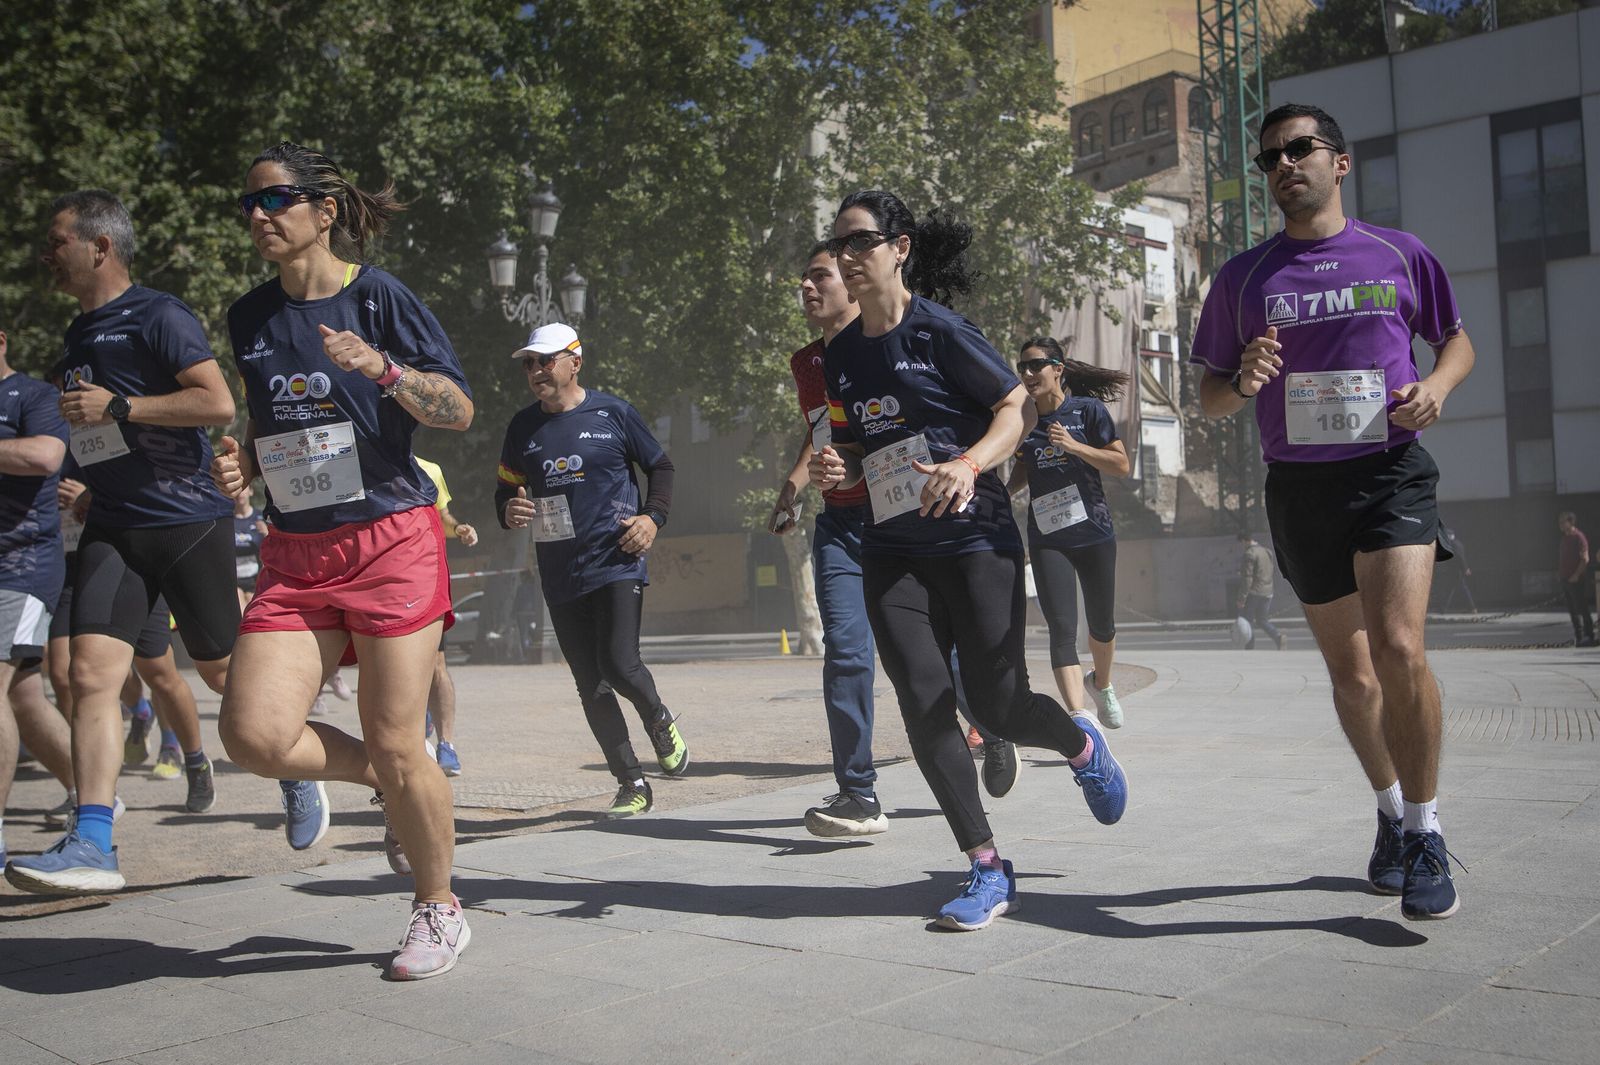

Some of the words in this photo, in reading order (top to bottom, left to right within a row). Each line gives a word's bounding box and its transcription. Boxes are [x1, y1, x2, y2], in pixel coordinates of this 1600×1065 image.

[1314, 260, 1338, 272] vive
[269, 372, 331, 402] 200
[1290, 388, 1314, 398] alsa
[272, 403, 320, 413] POLICIA
[275, 410, 336, 420] NACIONAL
[853, 395, 900, 423] 200
[1317, 412, 1360, 431] 180
[80, 436, 105, 455] 235
[262, 453, 284, 464] alsa
[308, 453, 330, 463] asisa
[543, 454, 583, 477] 200
[290, 472, 333, 496] 398
[884, 480, 915, 504] 181
